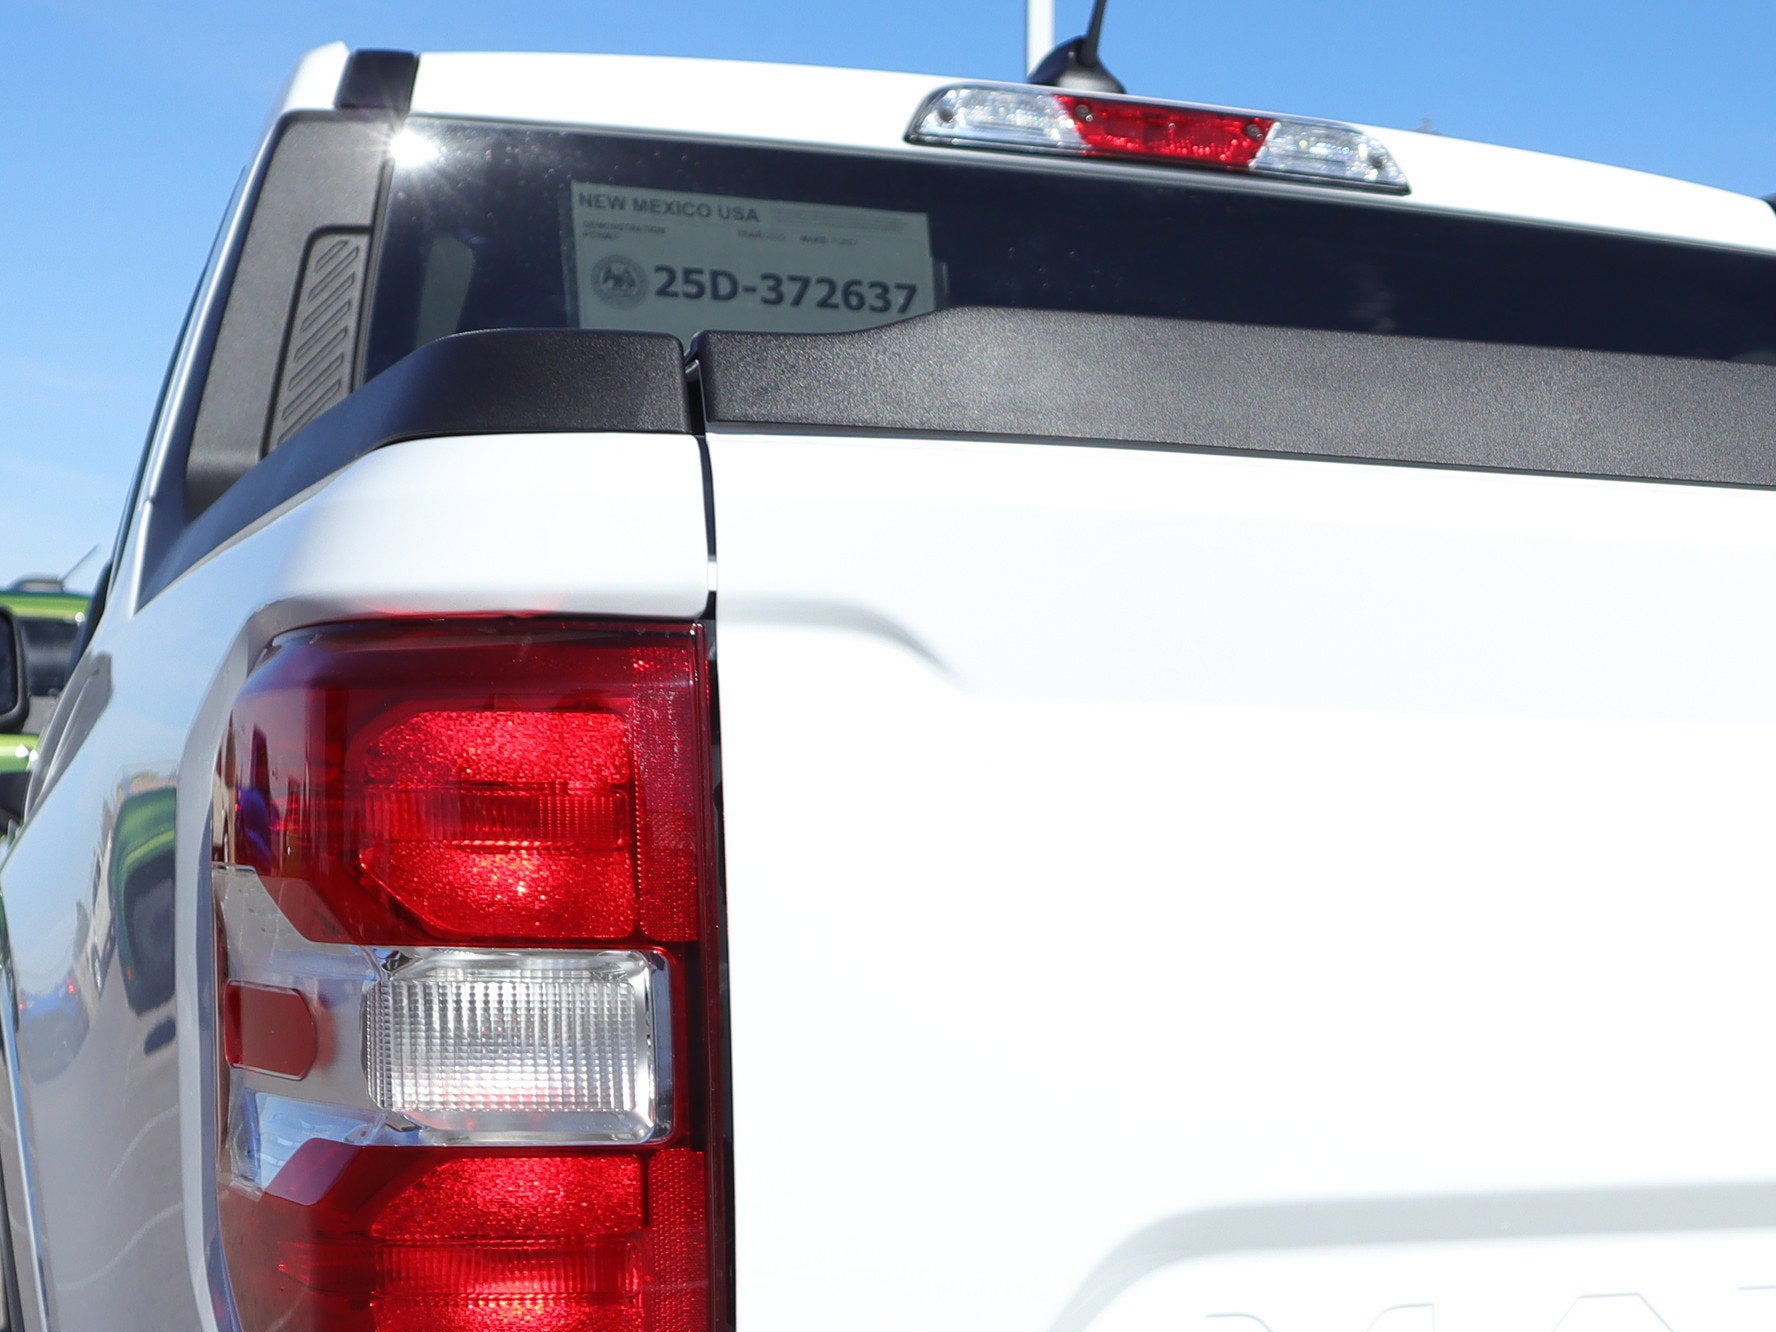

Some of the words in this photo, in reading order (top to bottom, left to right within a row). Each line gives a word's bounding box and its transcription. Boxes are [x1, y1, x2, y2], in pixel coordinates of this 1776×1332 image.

[578, 191, 626, 210] NEW
[632, 197, 712, 218] MEXICO
[717, 203, 760, 223] USA
[653, 262, 918, 314] 25D-372637
